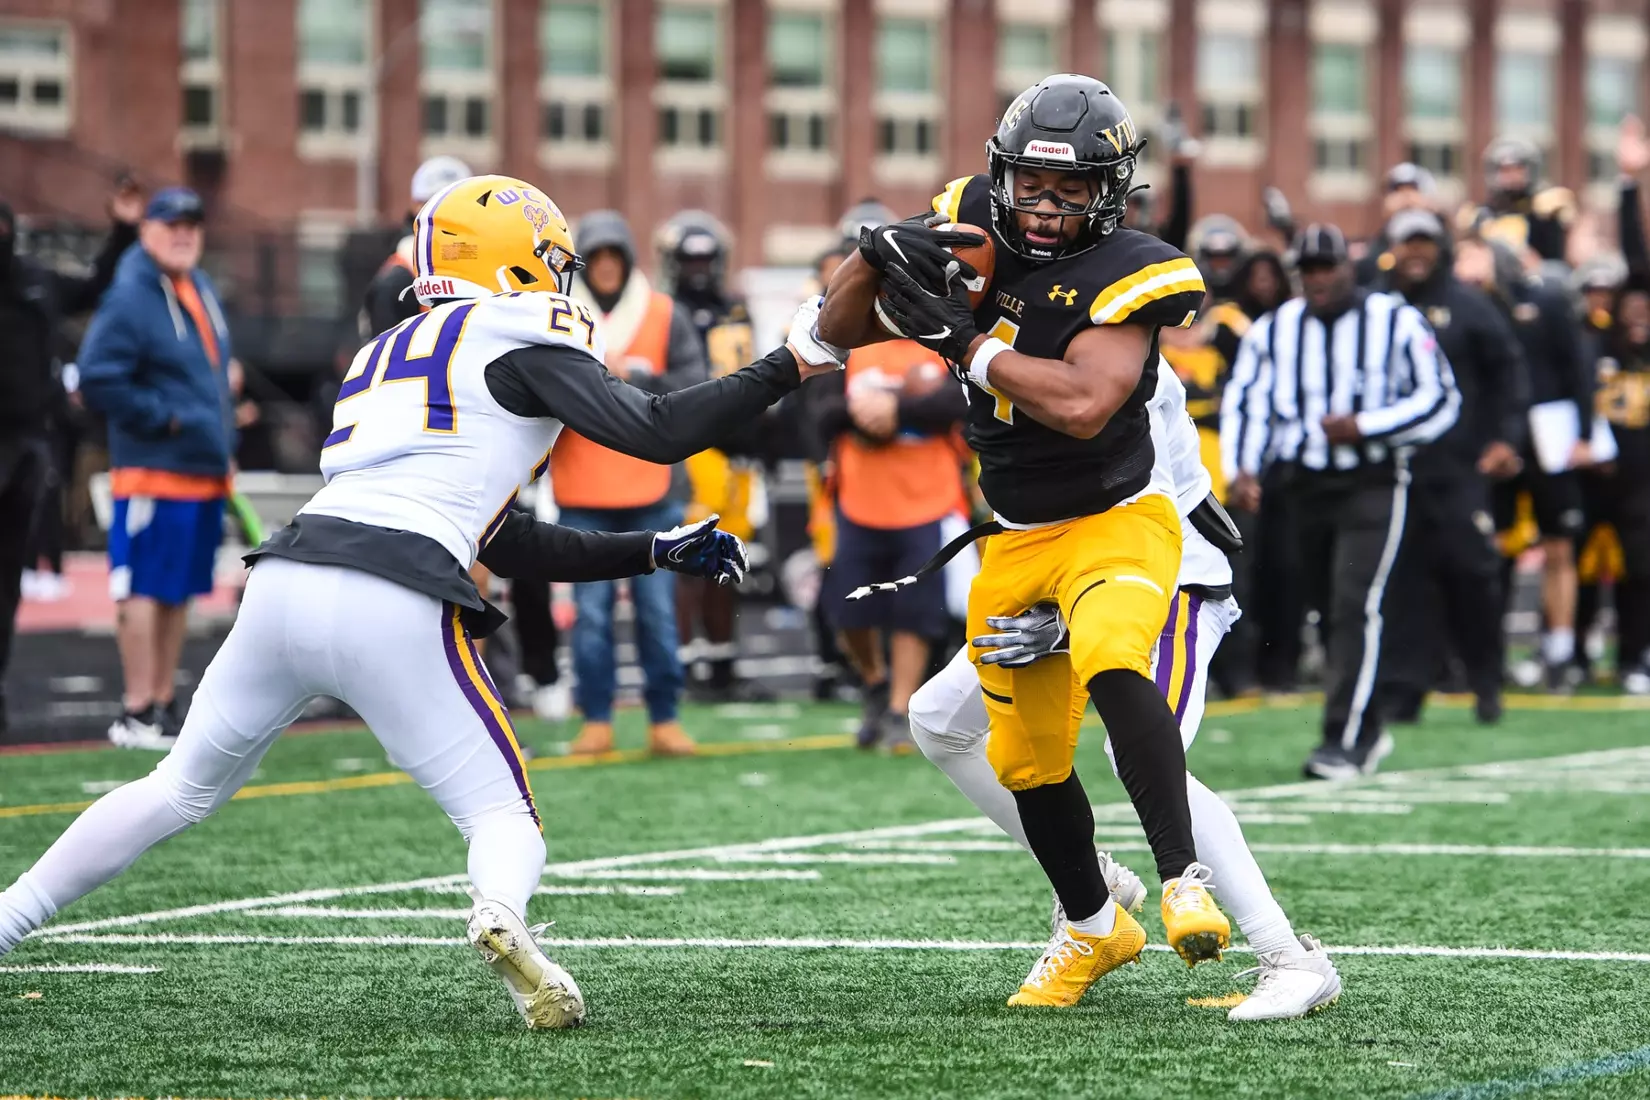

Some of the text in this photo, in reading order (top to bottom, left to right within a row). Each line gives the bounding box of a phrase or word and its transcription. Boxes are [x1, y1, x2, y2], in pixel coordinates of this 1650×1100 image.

[1030, 143, 1069, 155] Riddell
[548, 296, 597, 350] 24
[995, 290, 1025, 318] VILLE
[321, 301, 481, 450] 24
